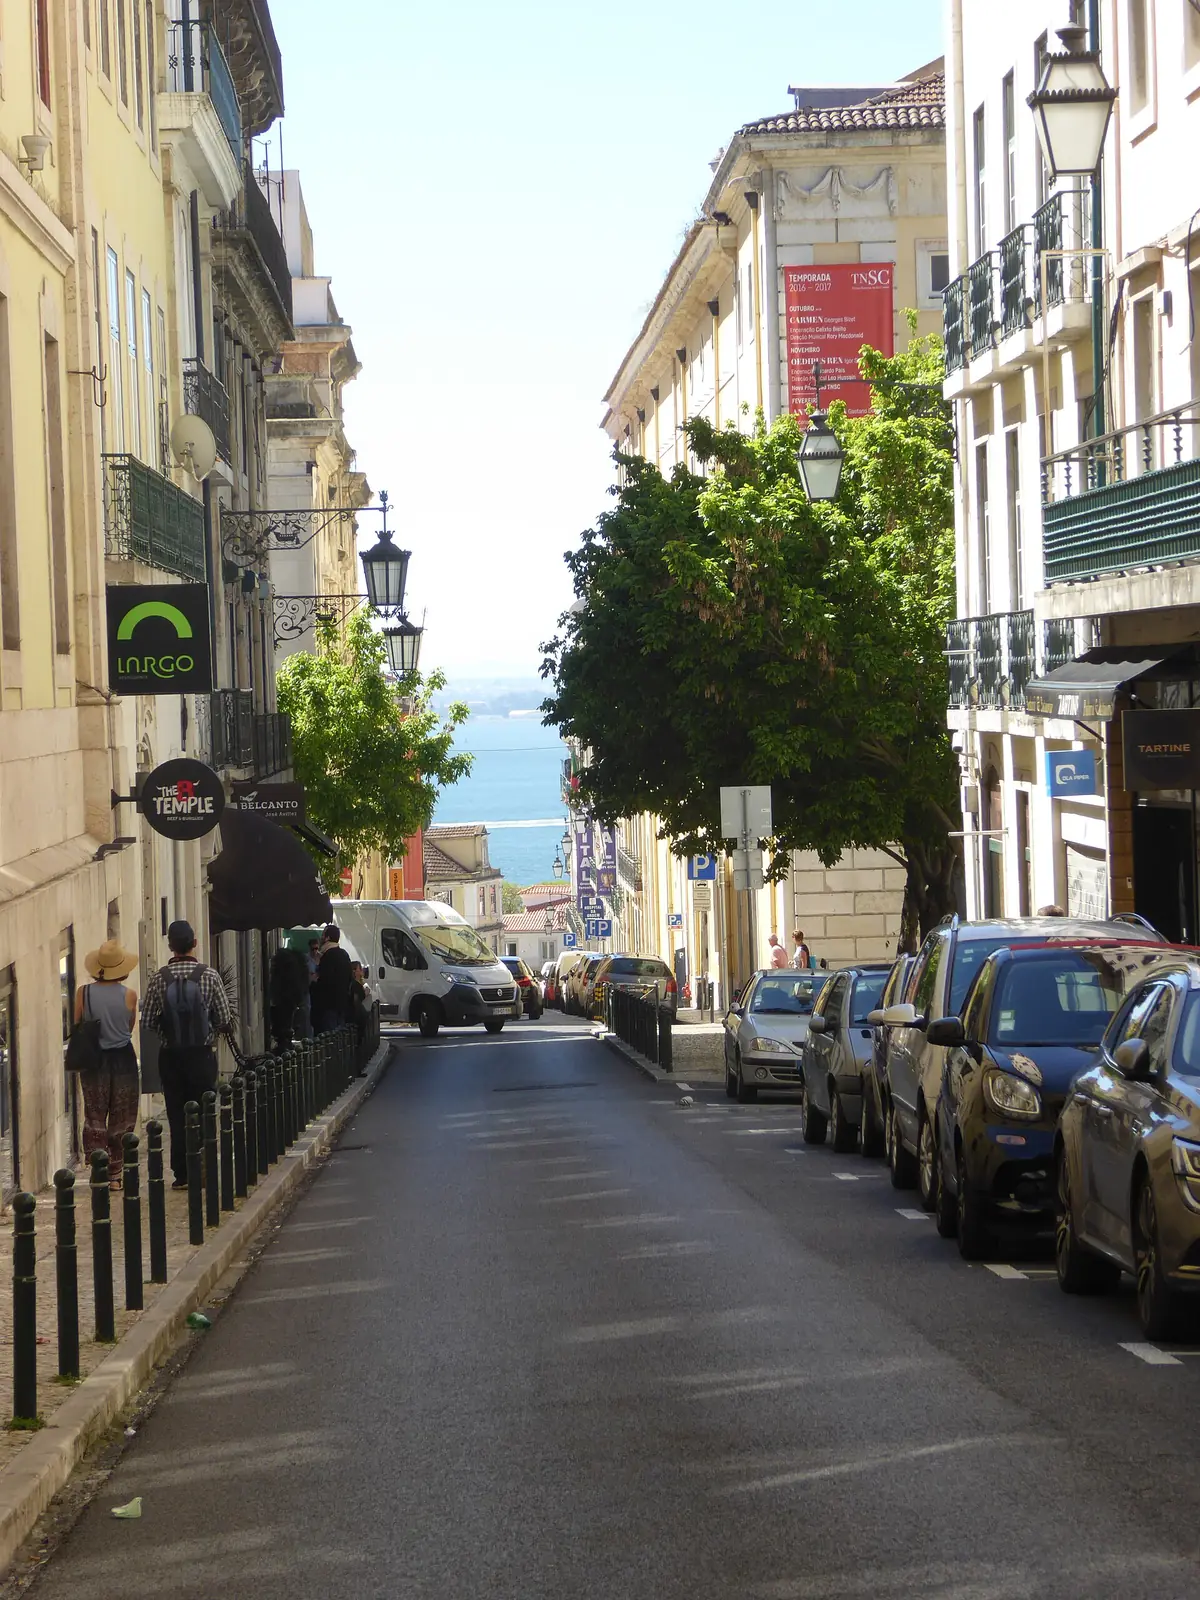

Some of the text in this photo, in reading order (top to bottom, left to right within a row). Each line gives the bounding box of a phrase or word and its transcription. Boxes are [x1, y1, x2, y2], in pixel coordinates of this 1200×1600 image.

[789, 273, 831, 282] TEMPORADA
[850, 269, 890, 286] TNSC
[789, 283, 806, 292] 2016
[815, 282, 832, 292] 2017
[789, 316, 823, 324] CARMEN
[117, 655, 194, 679] LARGO
[1137, 743, 1191, 753] TARTINE
[161, 785, 179, 798] THE
[152, 796, 214, 815] TEMPLE
[241, 800, 299, 810] BELCANTO
[692, 853, 710, 878] P
[669, 915, 677, 925] P
[598, 921, 608, 936] P
[566, 934, 574, 946] P
